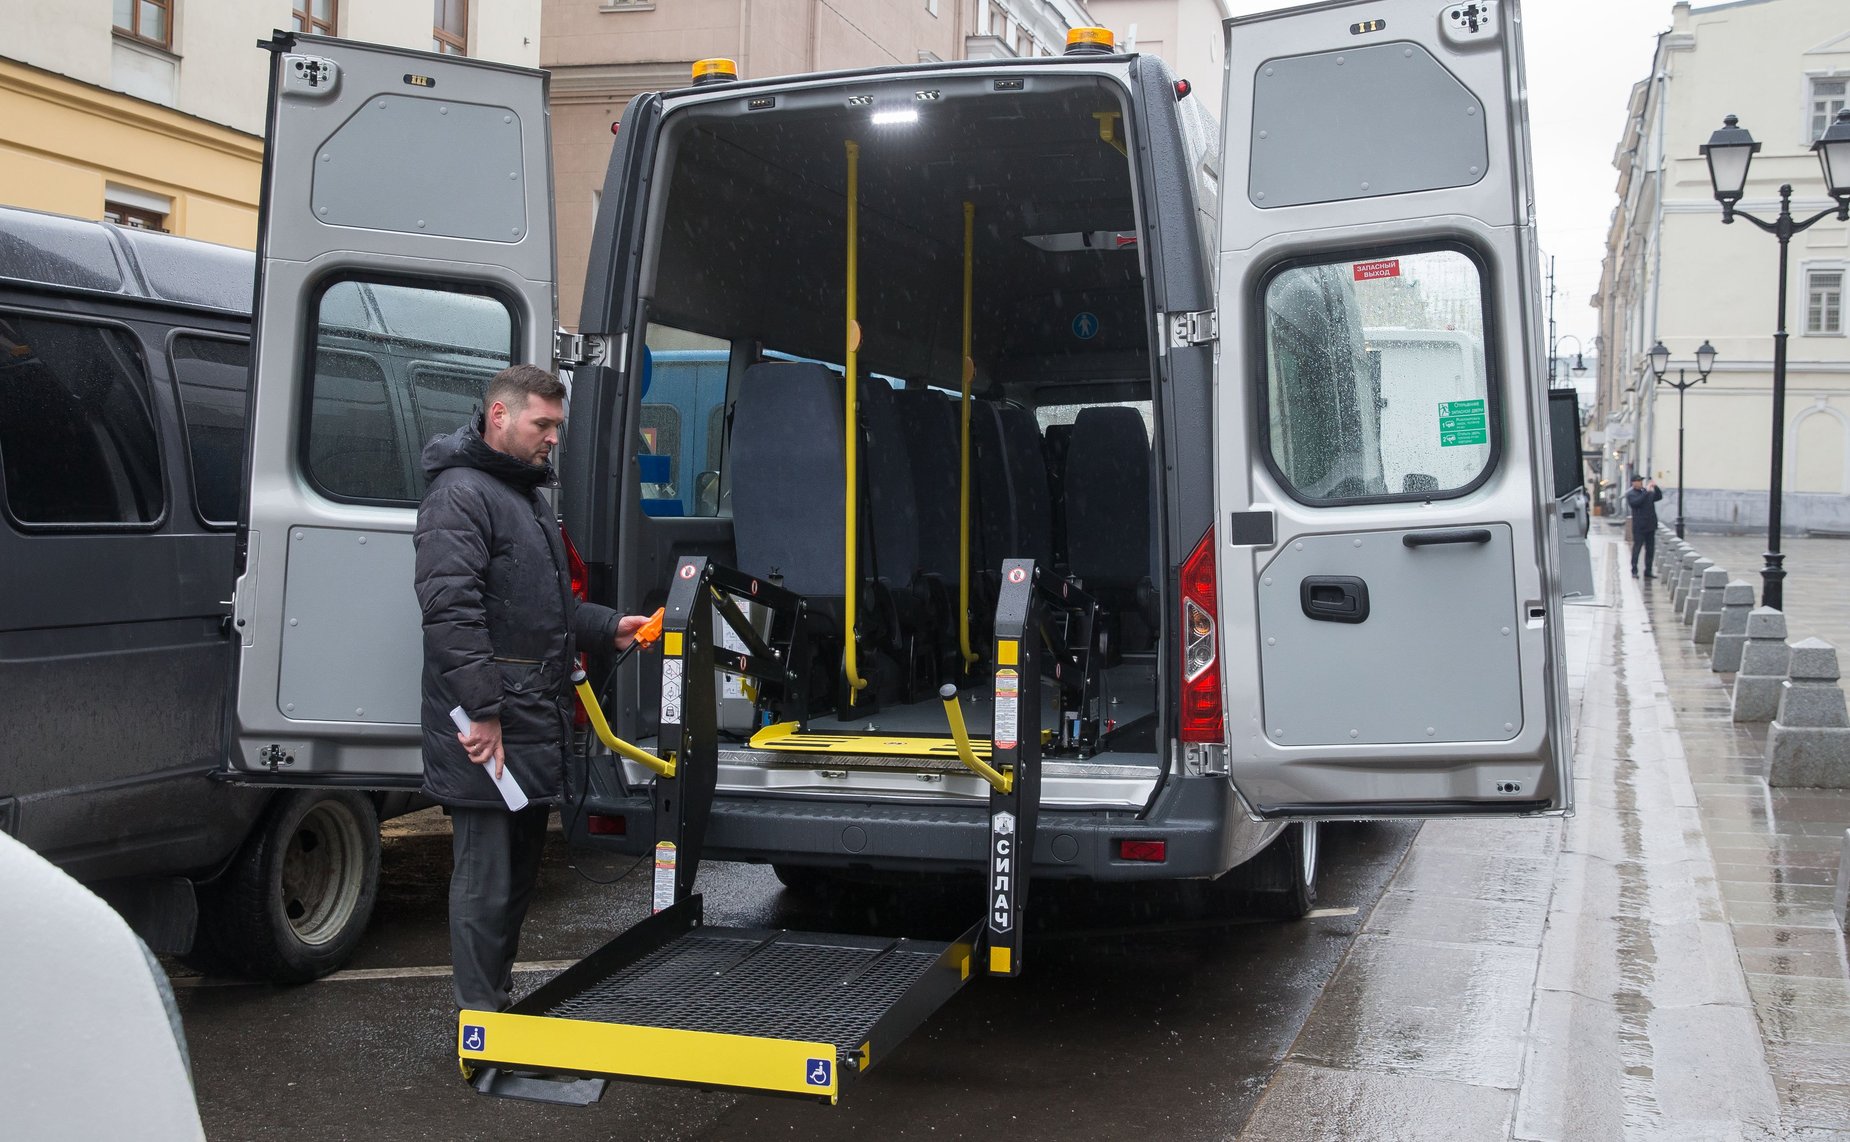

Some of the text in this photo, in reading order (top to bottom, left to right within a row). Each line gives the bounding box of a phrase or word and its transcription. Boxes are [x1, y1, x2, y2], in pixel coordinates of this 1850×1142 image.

[1357, 261, 1396, 272] ЗАПАСНЫЙ
[1364, 270, 1390, 278] ВЫХОД
[994, 839, 1010, 927] СИЛАЧ
